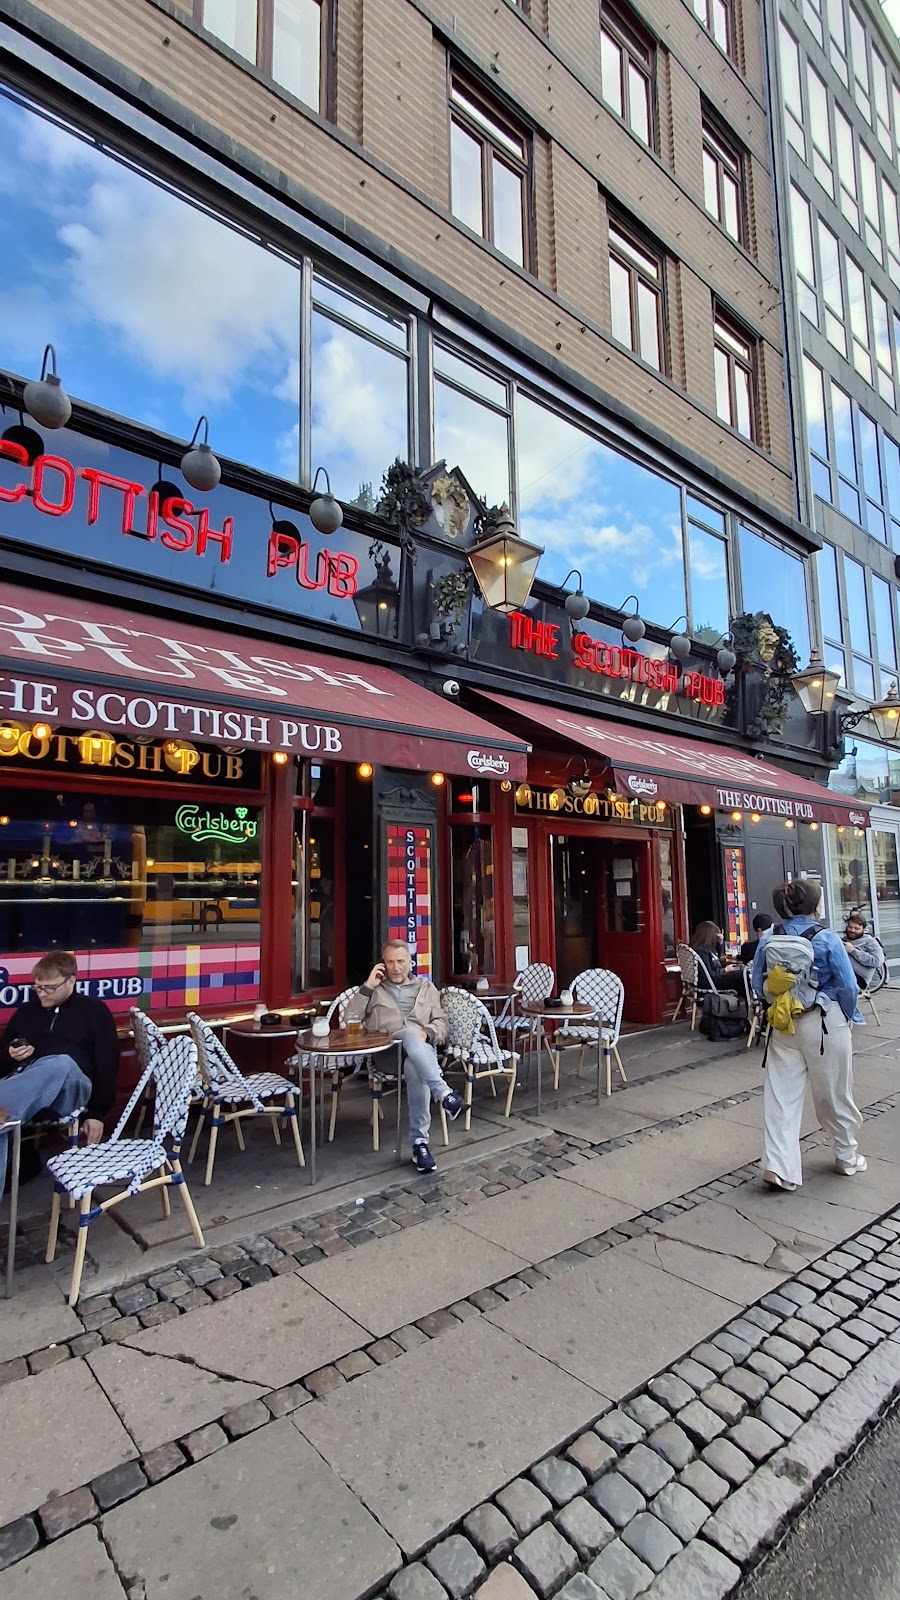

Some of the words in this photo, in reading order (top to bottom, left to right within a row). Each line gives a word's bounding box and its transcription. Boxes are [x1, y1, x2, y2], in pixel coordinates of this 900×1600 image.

[266, 530, 358, 599] PUB
[506, 611, 561, 660] THE
[571, 633, 678, 694] SCOTTISH
[684, 670, 725, 706] PUB
[71, 689, 270, 745] SCOTTISH
[279, 720, 343, 752] PUB
[178, 748, 244, 780] PUB
[467, 750, 510, 775] Carlsberg
[627, 775, 658, 795] Carlsberg
[524, 789, 560, 812] THE
[564, 795, 635, 820] SCOTTISH
[639, 804, 666, 823] PUB
[716, 789, 742, 808] THE
[743, 793, 794, 816] SCOTTISH
[794, 803, 814, 819] PUB
[175, 805, 258, 842] Carlsberg
[405, 831, 416, 943] SCOTTISH
[97, 977, 143, 998] PUB
